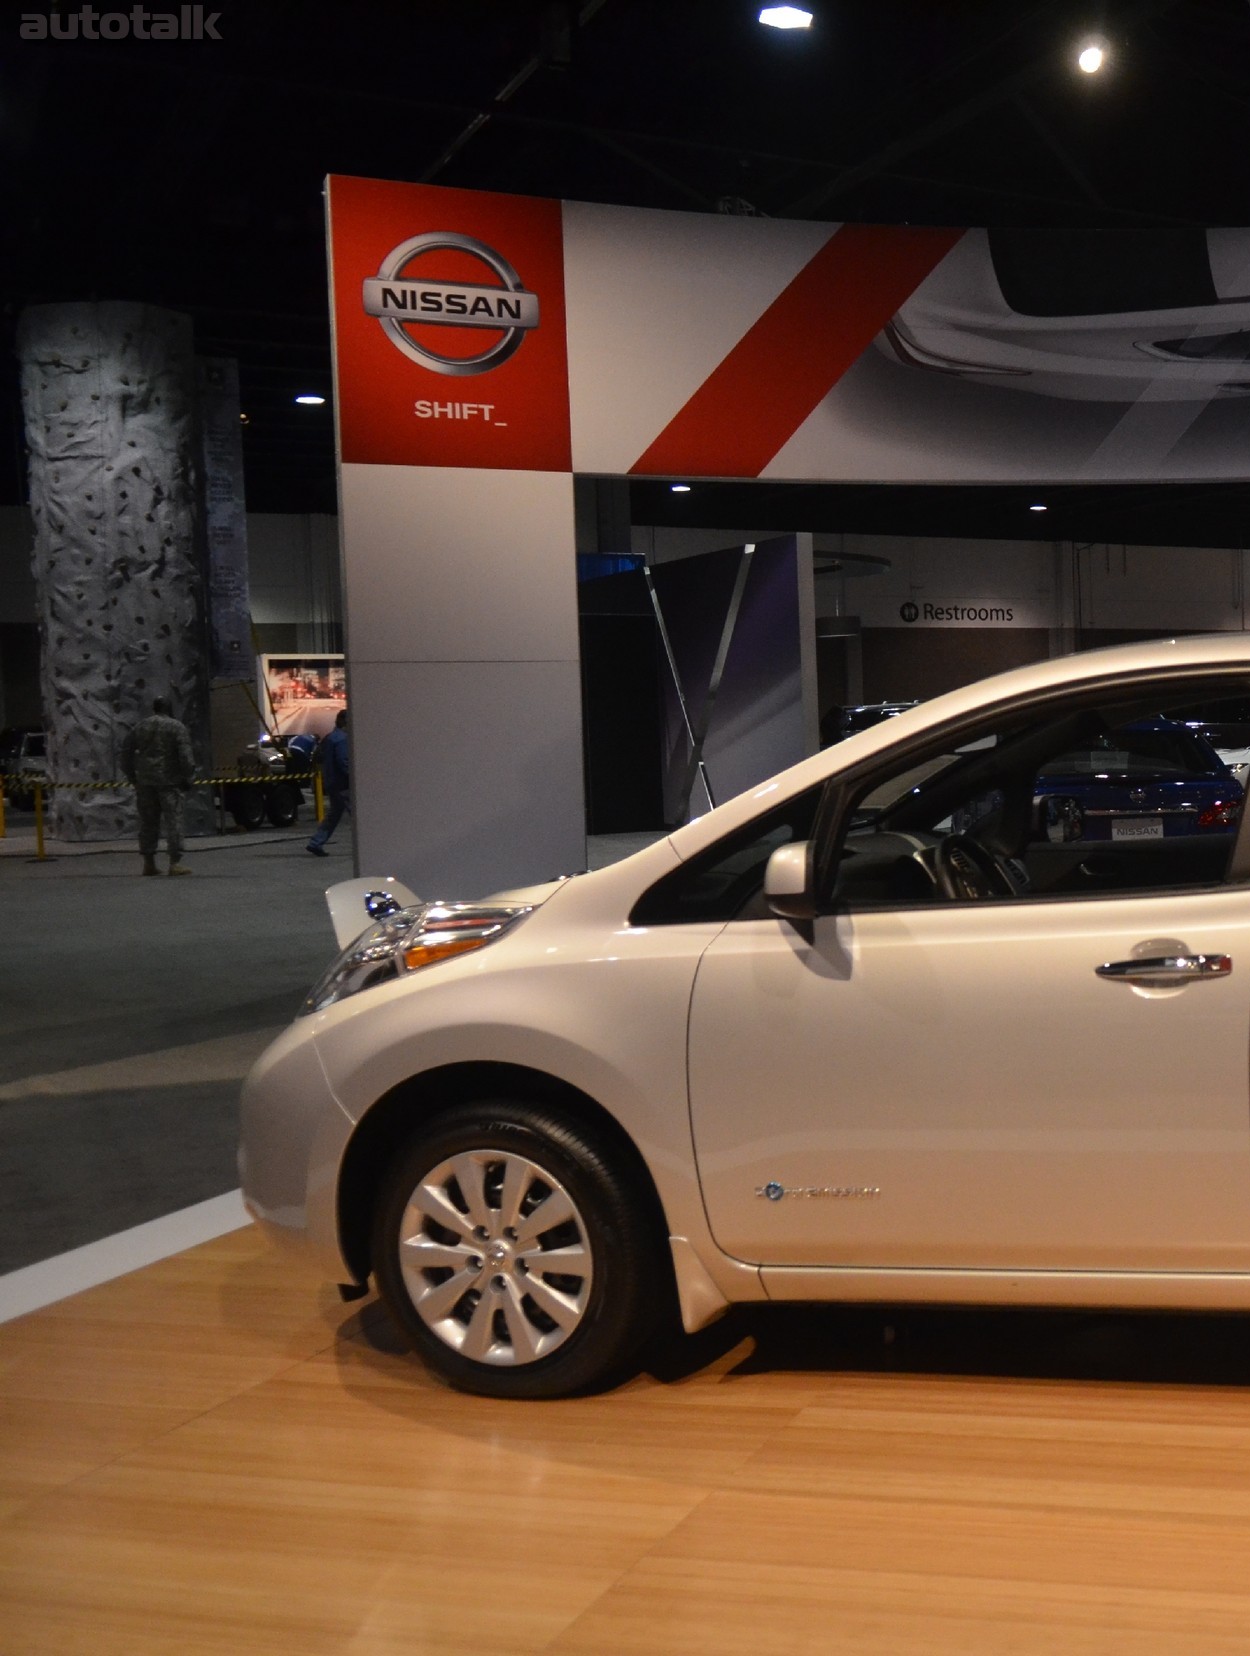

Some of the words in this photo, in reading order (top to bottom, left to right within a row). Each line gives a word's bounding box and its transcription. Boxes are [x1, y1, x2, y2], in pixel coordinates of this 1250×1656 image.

[382, 288, 521, 319] NISSAN
[415, 400, 507, 426] SHIFT_
[923, 603, 1014, 621] Restrooms
[1116, 827, 1158, 835] NISSAN
